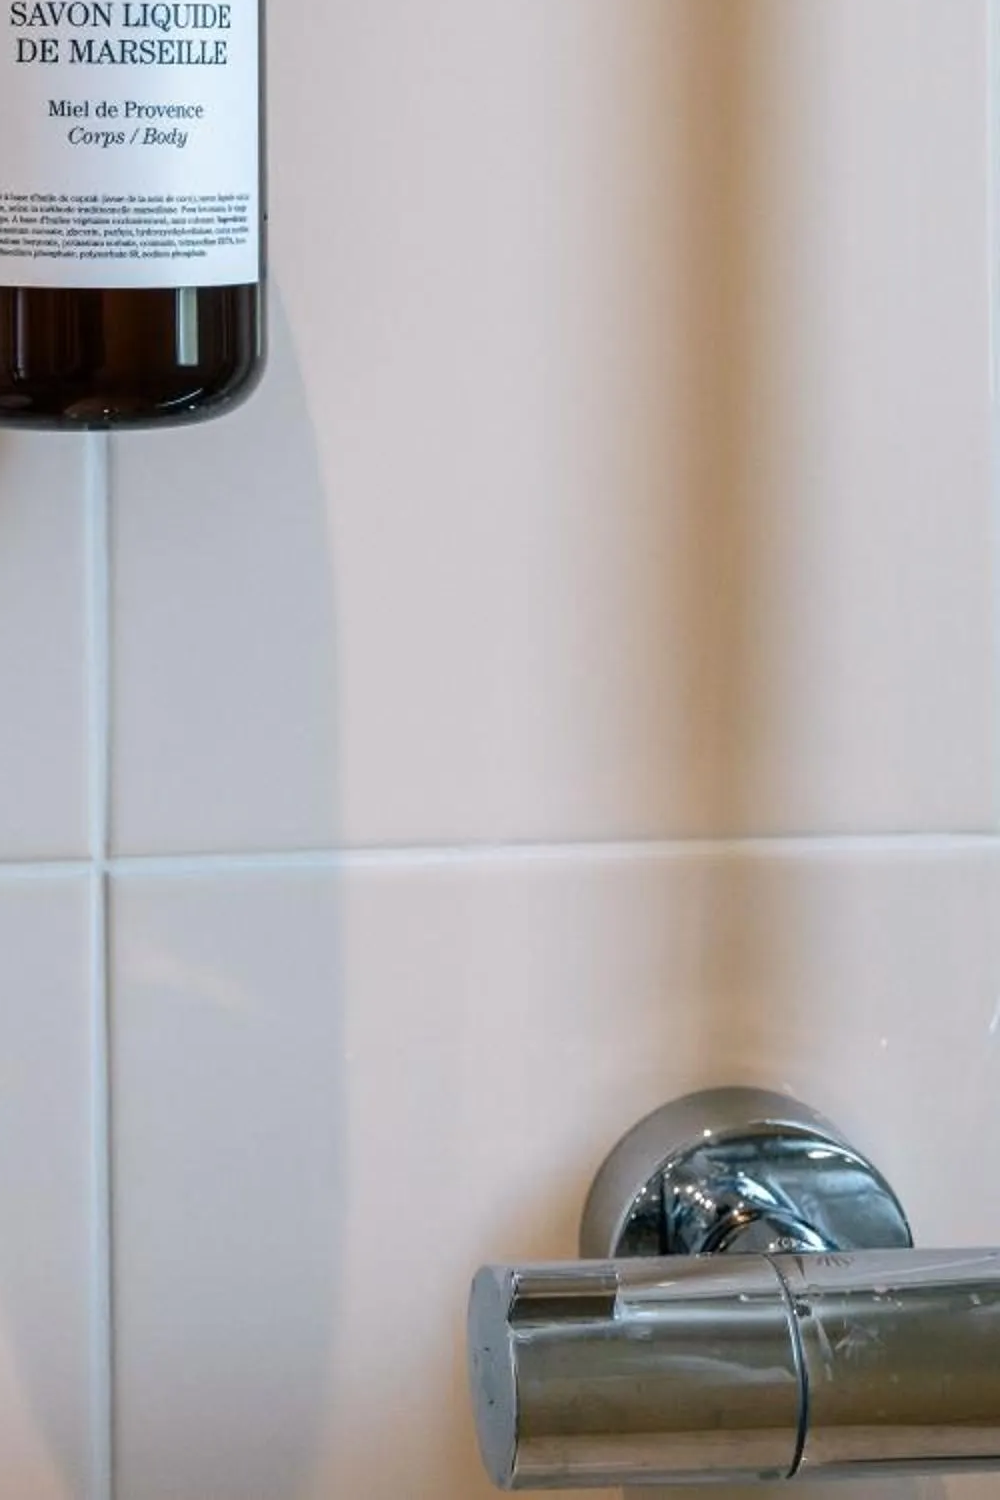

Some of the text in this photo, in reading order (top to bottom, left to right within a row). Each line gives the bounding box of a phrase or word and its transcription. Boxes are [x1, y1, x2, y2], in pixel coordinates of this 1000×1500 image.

[10, 1, 231, 32] SAVON LIQUIDE
[16, 38, 227, 65] DE MARSEILLE
[48, 100, 204, 119] Miel de Provence
[68, 126, 125, 148] Corps
[142, 128, 188, 149] Body
